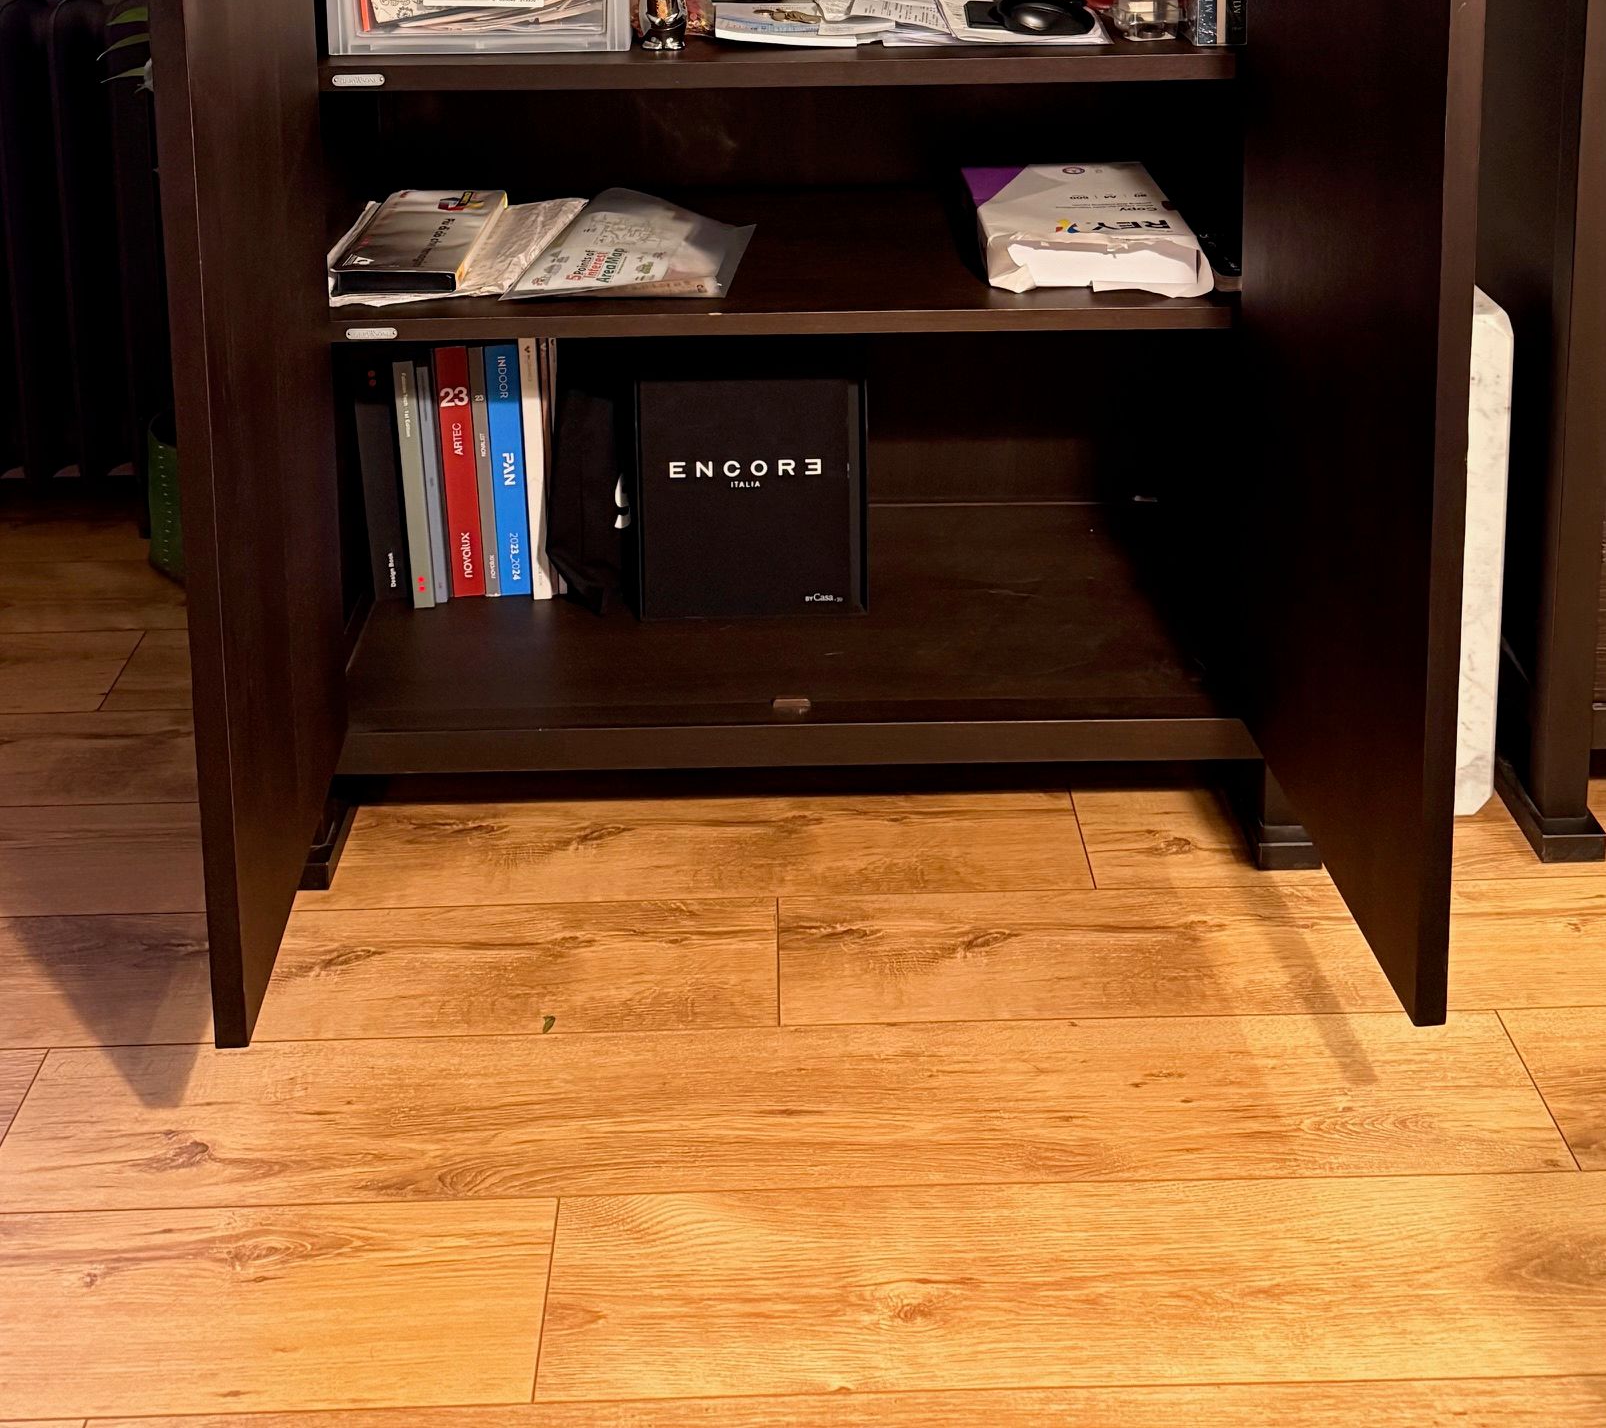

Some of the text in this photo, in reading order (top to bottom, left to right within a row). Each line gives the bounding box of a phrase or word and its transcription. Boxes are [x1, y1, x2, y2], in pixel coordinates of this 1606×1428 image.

[1092, 220, 1171, 231] REY
[573, 256, 592, 275] Points
[582, 252, 609, 278] Interest
[497, 356, 509, 399] INDOOR
[440, 387, 469, 408] 23
[474, 394, 485, 402] 23
[451, 422, 464, 456] ARTEC
[502, 452, 516, 486] PAN
[668, 459, 822, 478] ENCORE
[460, 532, 474, 578] novalux
